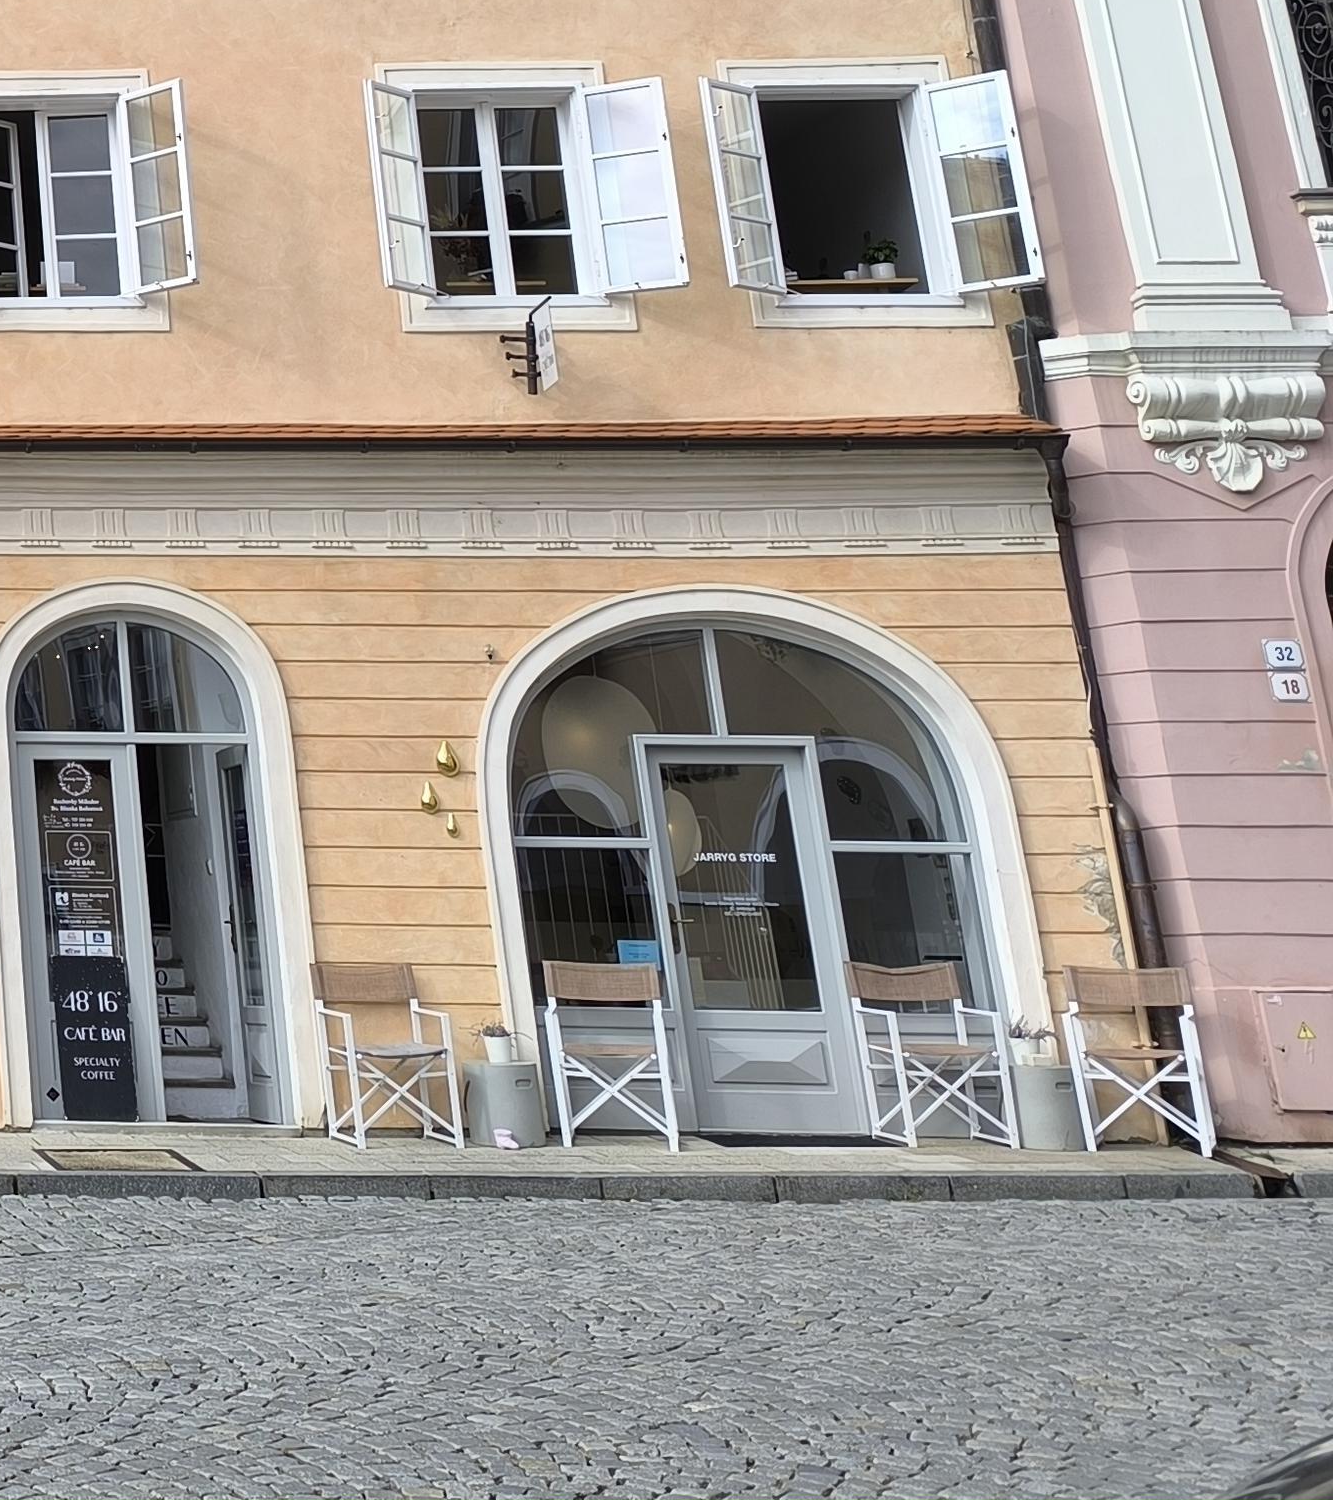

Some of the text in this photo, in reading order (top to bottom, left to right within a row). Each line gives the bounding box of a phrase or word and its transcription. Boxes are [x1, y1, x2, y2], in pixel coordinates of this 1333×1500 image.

[1274, 646, 1296, 661] 32
[1281, 679, 1301, 695] 18
[739, 853, 777, 863] STORE
[64, 1025, 126, 1042] CAFÉ BAR
[73, 1056, 122, 1067] SPECIALTY
[80, 1070, 117, 1081] COFFEE
